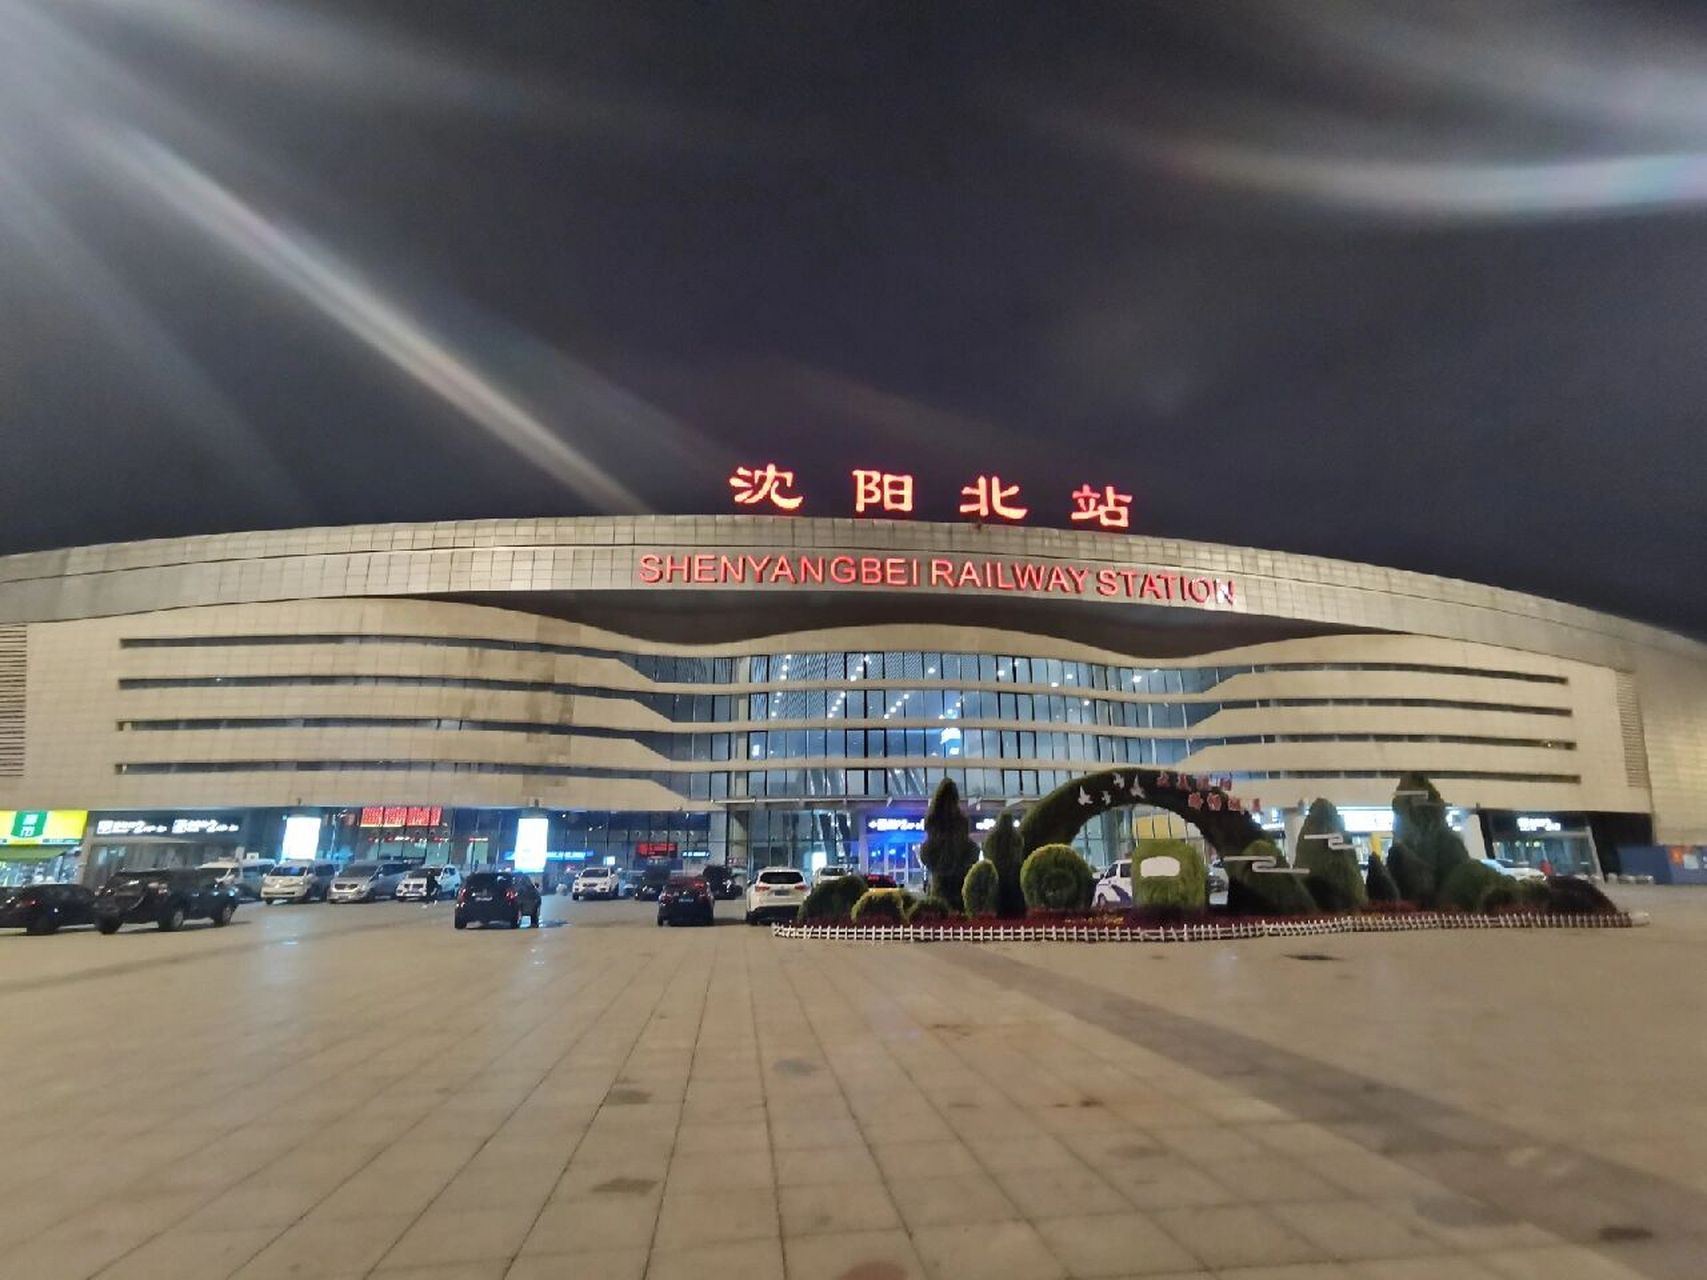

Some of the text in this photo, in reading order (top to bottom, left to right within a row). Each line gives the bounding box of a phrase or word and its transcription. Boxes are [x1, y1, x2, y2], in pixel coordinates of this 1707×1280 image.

[729, 463, 1133, 529] 沈阳北站
[638, 554, 1236, 605] SHENYANGBEI RAILWAY STATION
